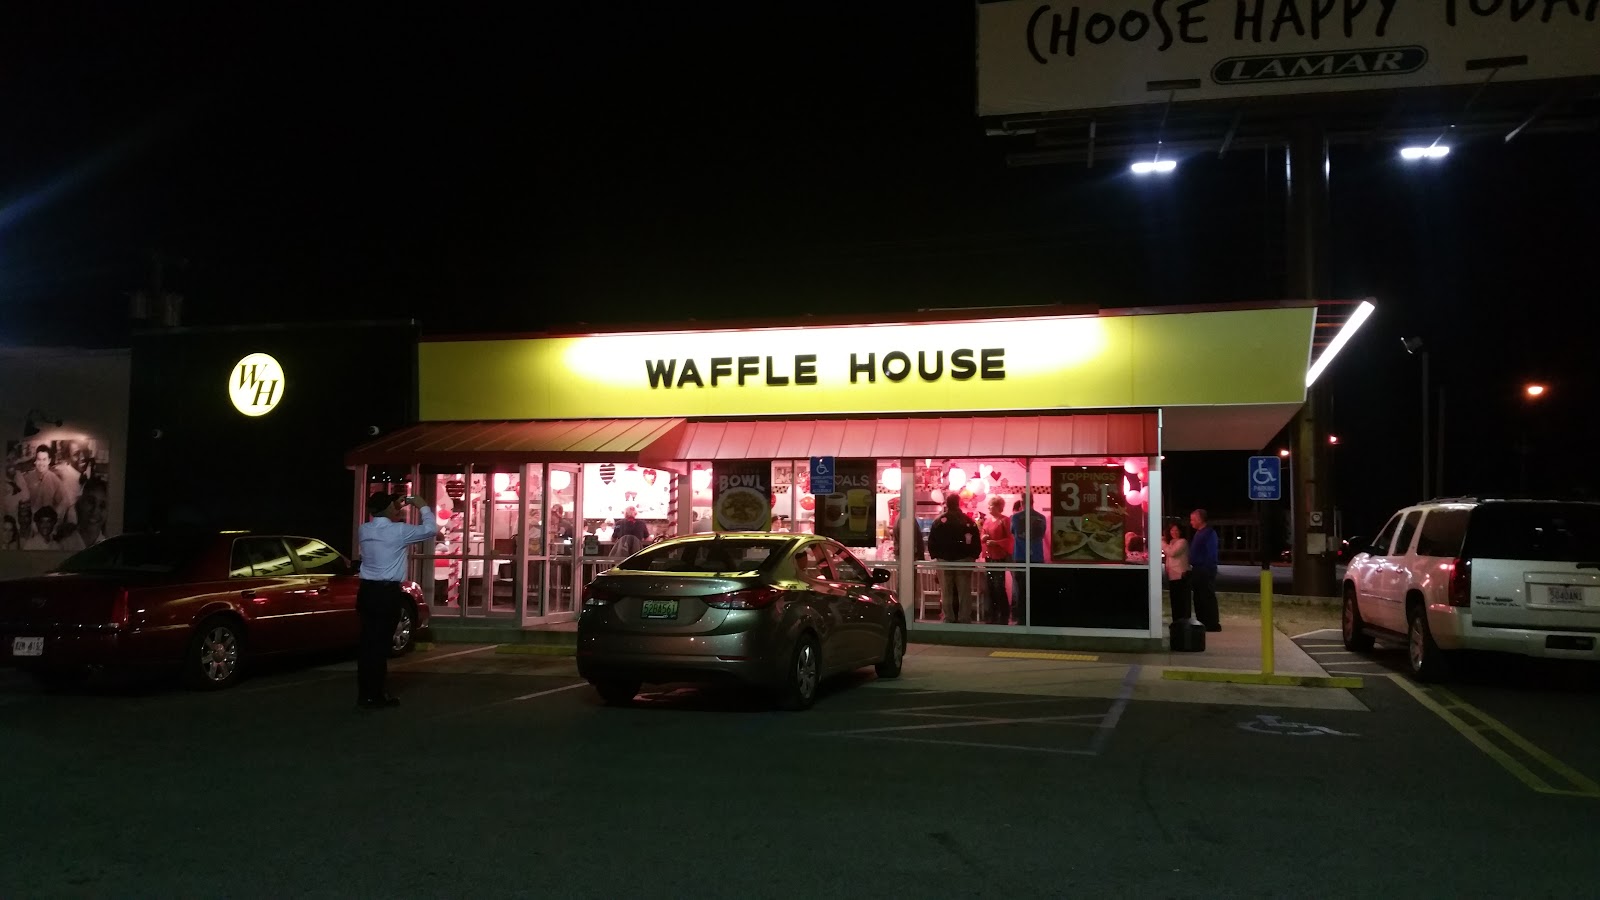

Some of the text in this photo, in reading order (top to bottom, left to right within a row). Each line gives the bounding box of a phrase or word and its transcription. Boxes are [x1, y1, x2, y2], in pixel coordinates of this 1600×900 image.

[1027, 0, 1208, 64] CHOOSE
[1234, 0, 1397, 42] HAPPY
[1229, 51, 1404, 80] LAMAR
[645, 348, 1006, 389] WAFFLE HOUSE
[718, 474, 766, 492] BOWL
[1060, 472, 1117, 481] TOPPINGS
[1060, 482, 1080, 511] 3
[1082, 493, 1098, 503] FOR
